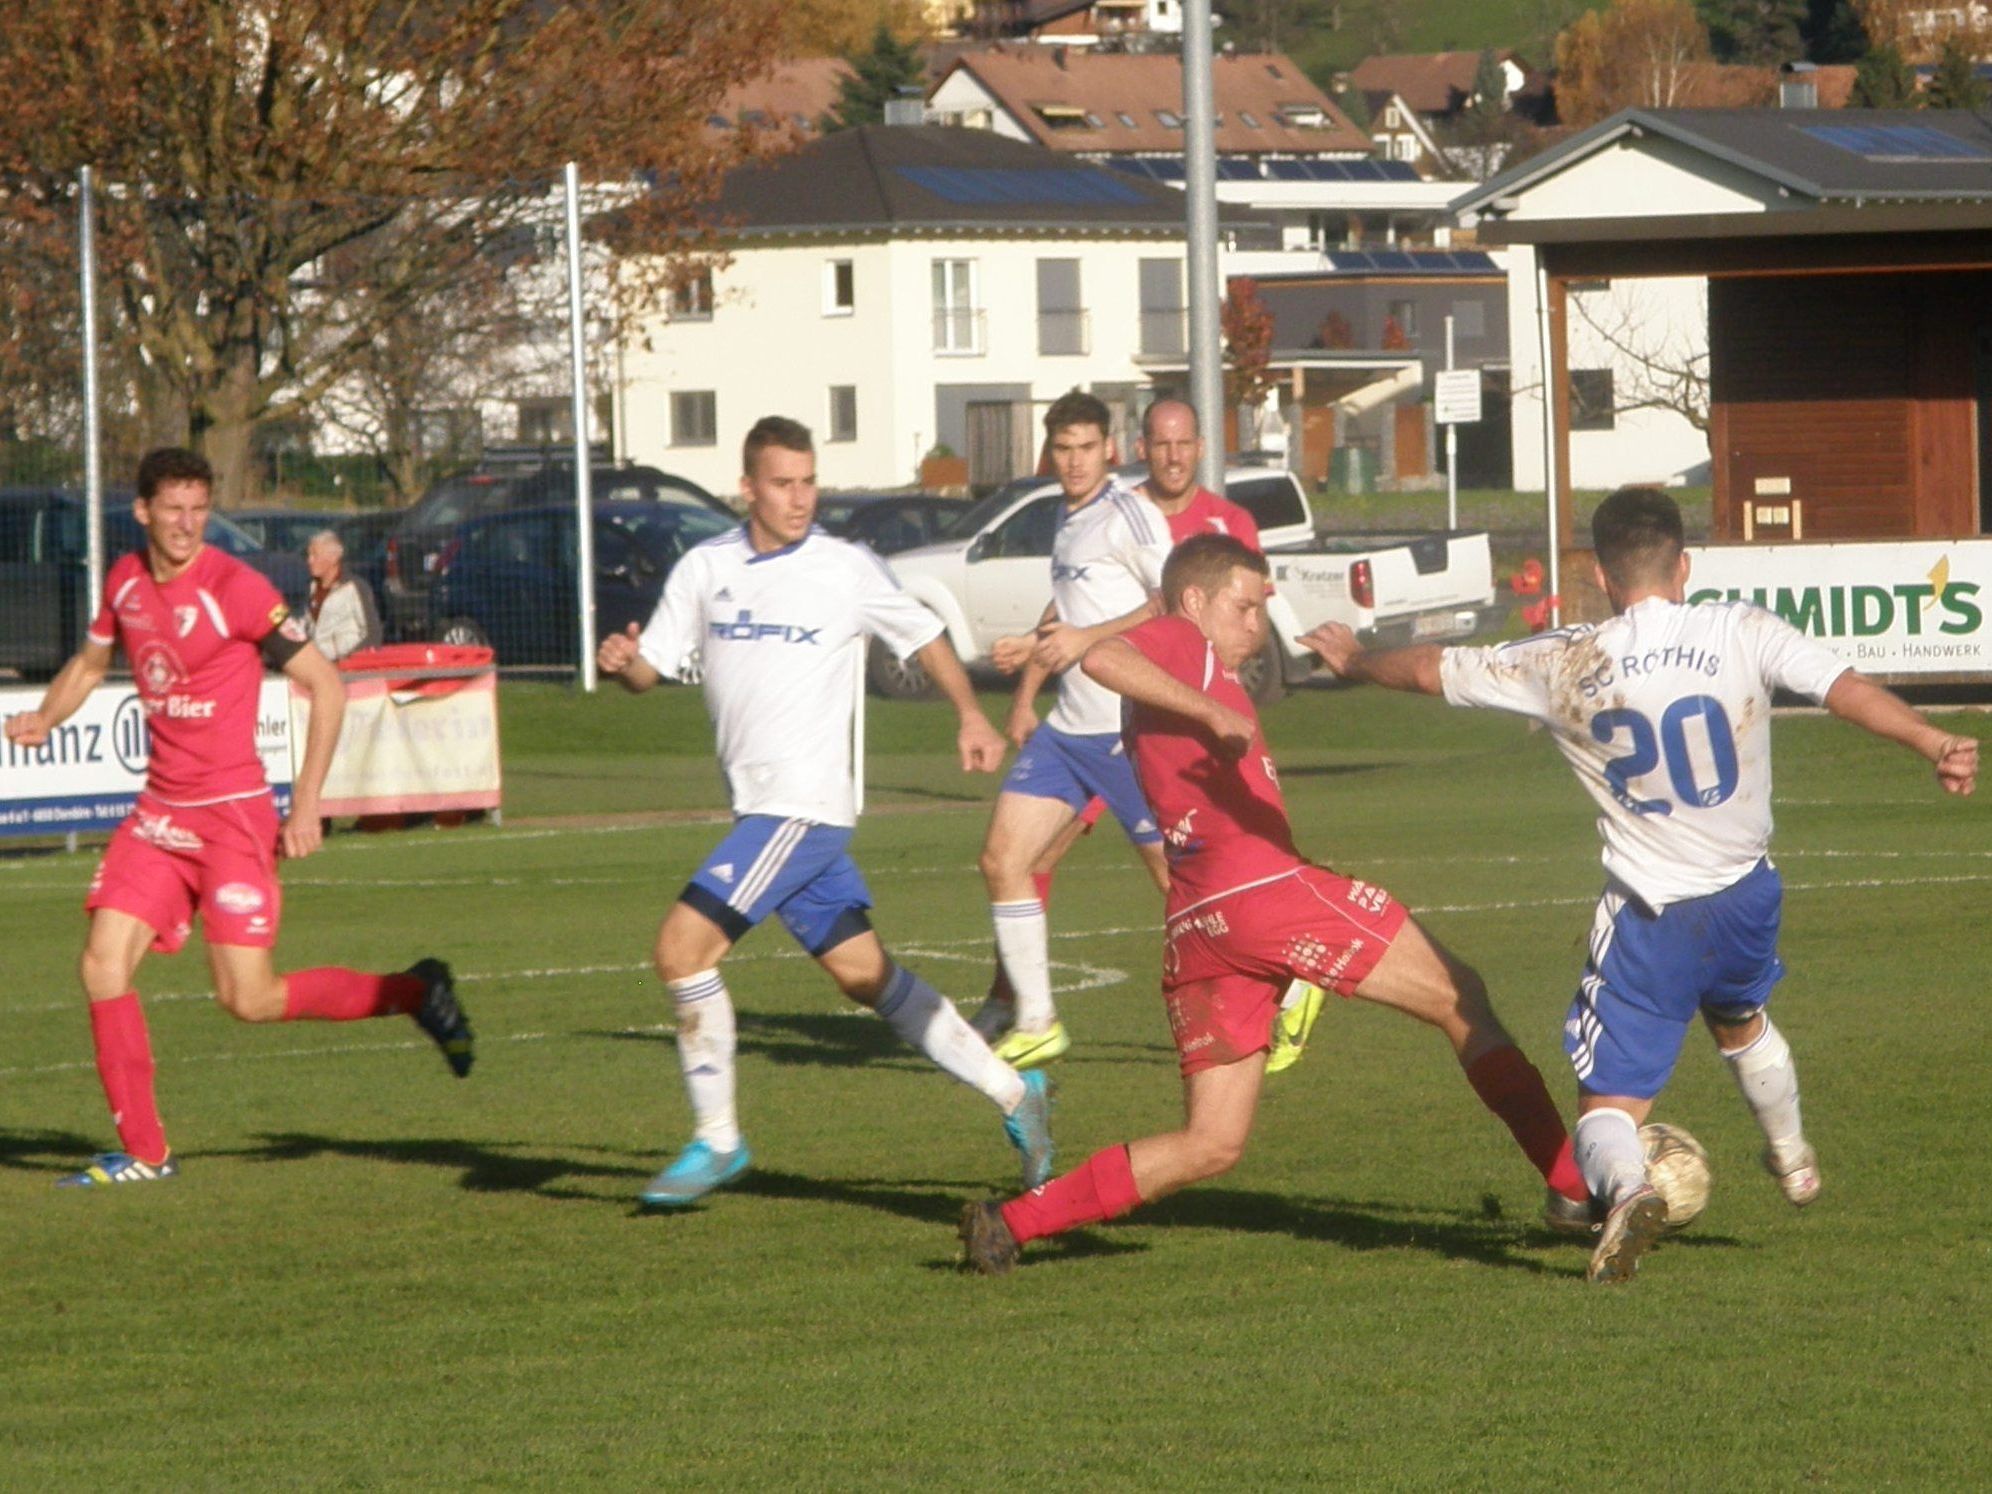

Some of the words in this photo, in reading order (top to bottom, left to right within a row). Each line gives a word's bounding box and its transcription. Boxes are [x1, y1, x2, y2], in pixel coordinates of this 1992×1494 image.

[1579, 662, 1615, 698] SC
[166, 695, 216, 718] Bier
[1591, 694, 1740, 816] 20
